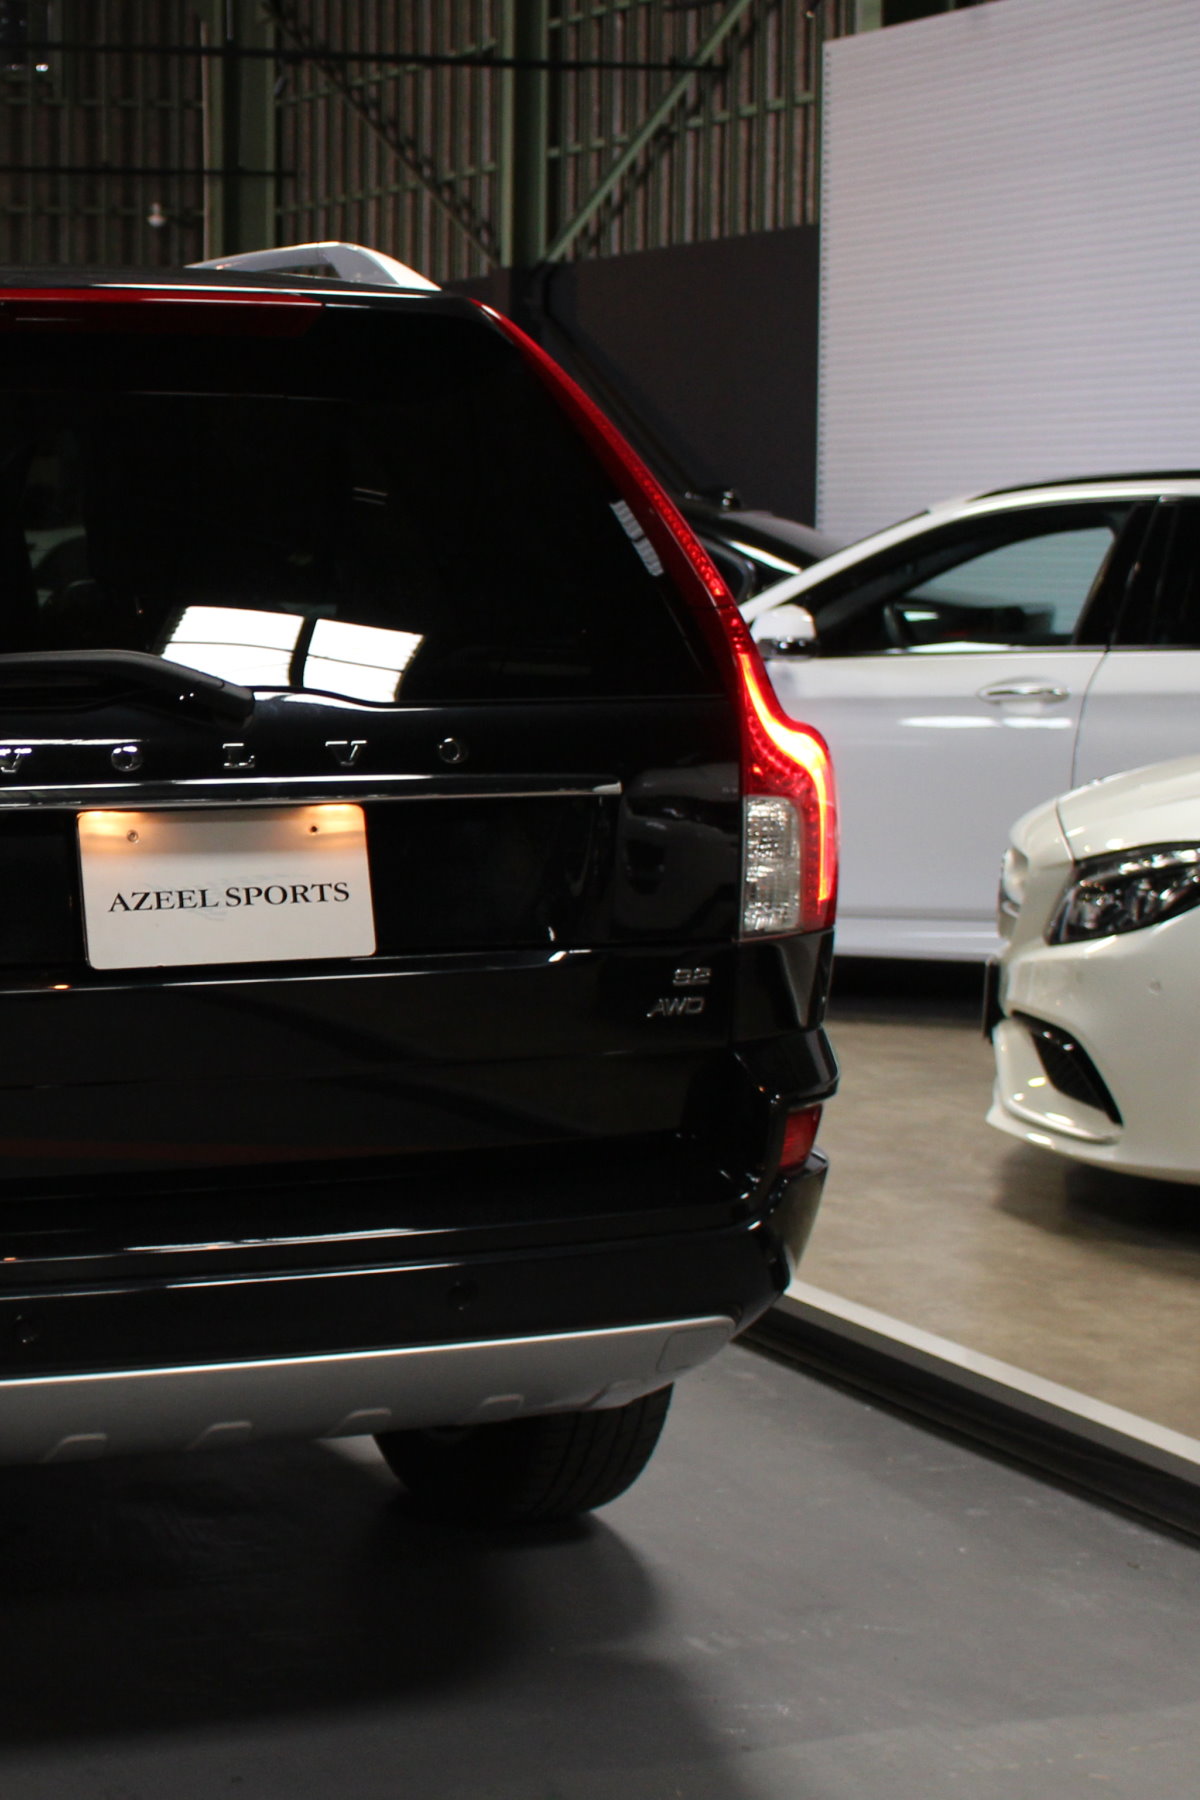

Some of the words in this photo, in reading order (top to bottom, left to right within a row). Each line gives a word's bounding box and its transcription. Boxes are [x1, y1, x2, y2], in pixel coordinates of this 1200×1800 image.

[108, 888, 219, 913] AZEEL
[225, 882, 350, 907] SPORTS
[646, 997, 705, 1018] AWD
